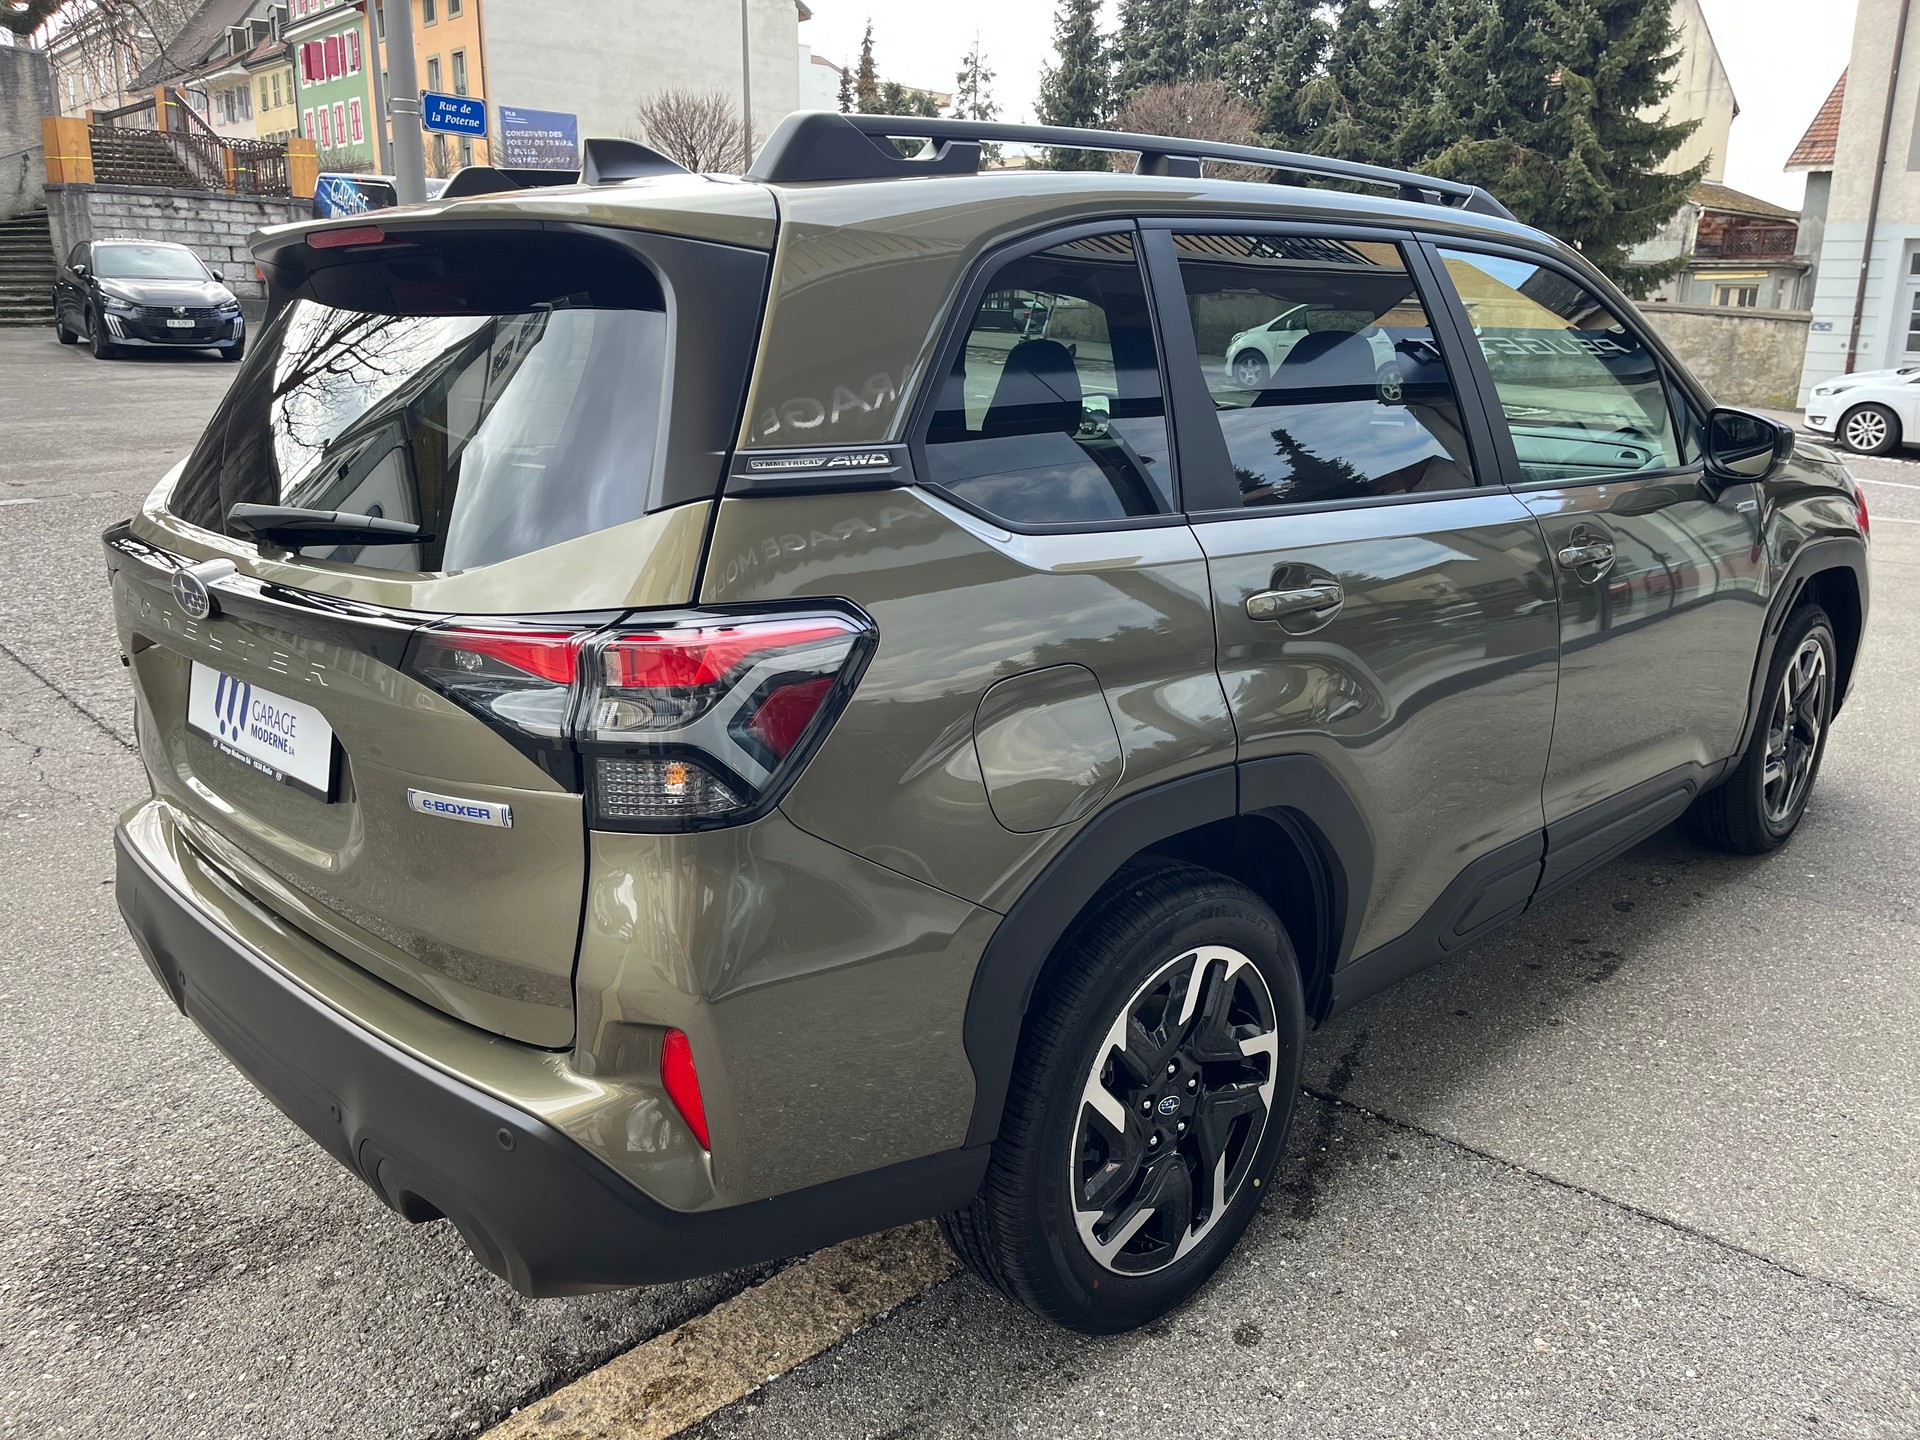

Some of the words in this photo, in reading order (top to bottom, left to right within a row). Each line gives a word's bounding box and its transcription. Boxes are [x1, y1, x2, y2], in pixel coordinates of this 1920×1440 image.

[439, 101, 457, 112] Rue
[460, 104, 472, 114] de
[431, 111, 441, 122] la
[444, 114, 480, 128] Poterne
[505, 130, 548, 138] CONSERVER
[331, 179, 369, 214] GARAGE
[752, 459, 820, 468] SYMMETRICAL
[826, 453, 889, 467] AWD
[125, 587, 329, 687] FORESTER
[252, 700, 297, 738] GARAGE
[220, 743, 231, 755] Garage
[250, 723, 288, 753] MODERNE
[288, 746, 295, 757] SA
[422, 799, 491, 819] e-BOXER
